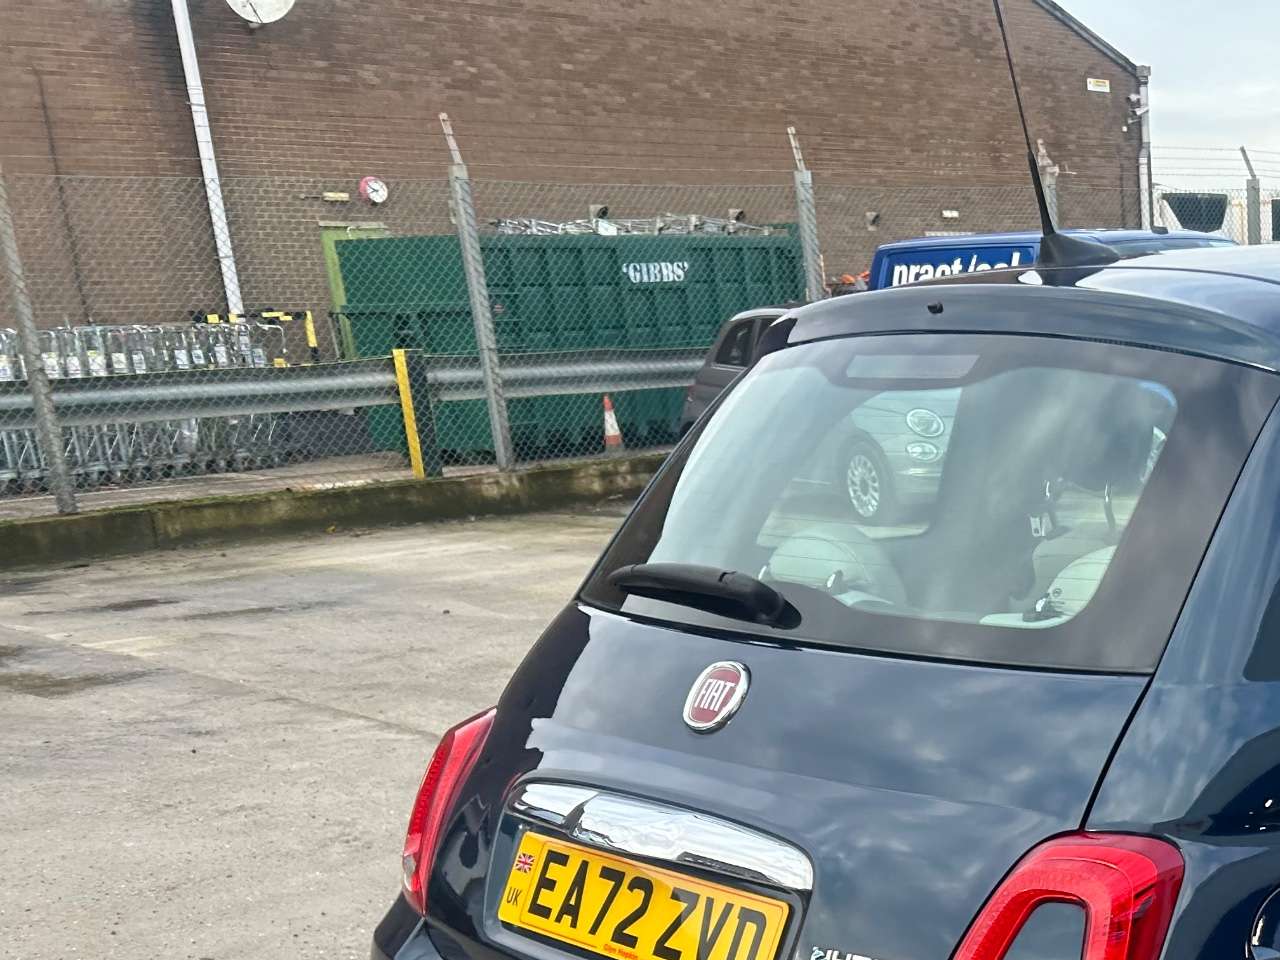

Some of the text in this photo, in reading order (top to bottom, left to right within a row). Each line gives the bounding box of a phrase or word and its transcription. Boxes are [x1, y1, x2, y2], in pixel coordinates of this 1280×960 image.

[694, 679, 736, 711] FIAT
[506, 886, 522, 907] UK
[528, 849, 654, 949] EA72
